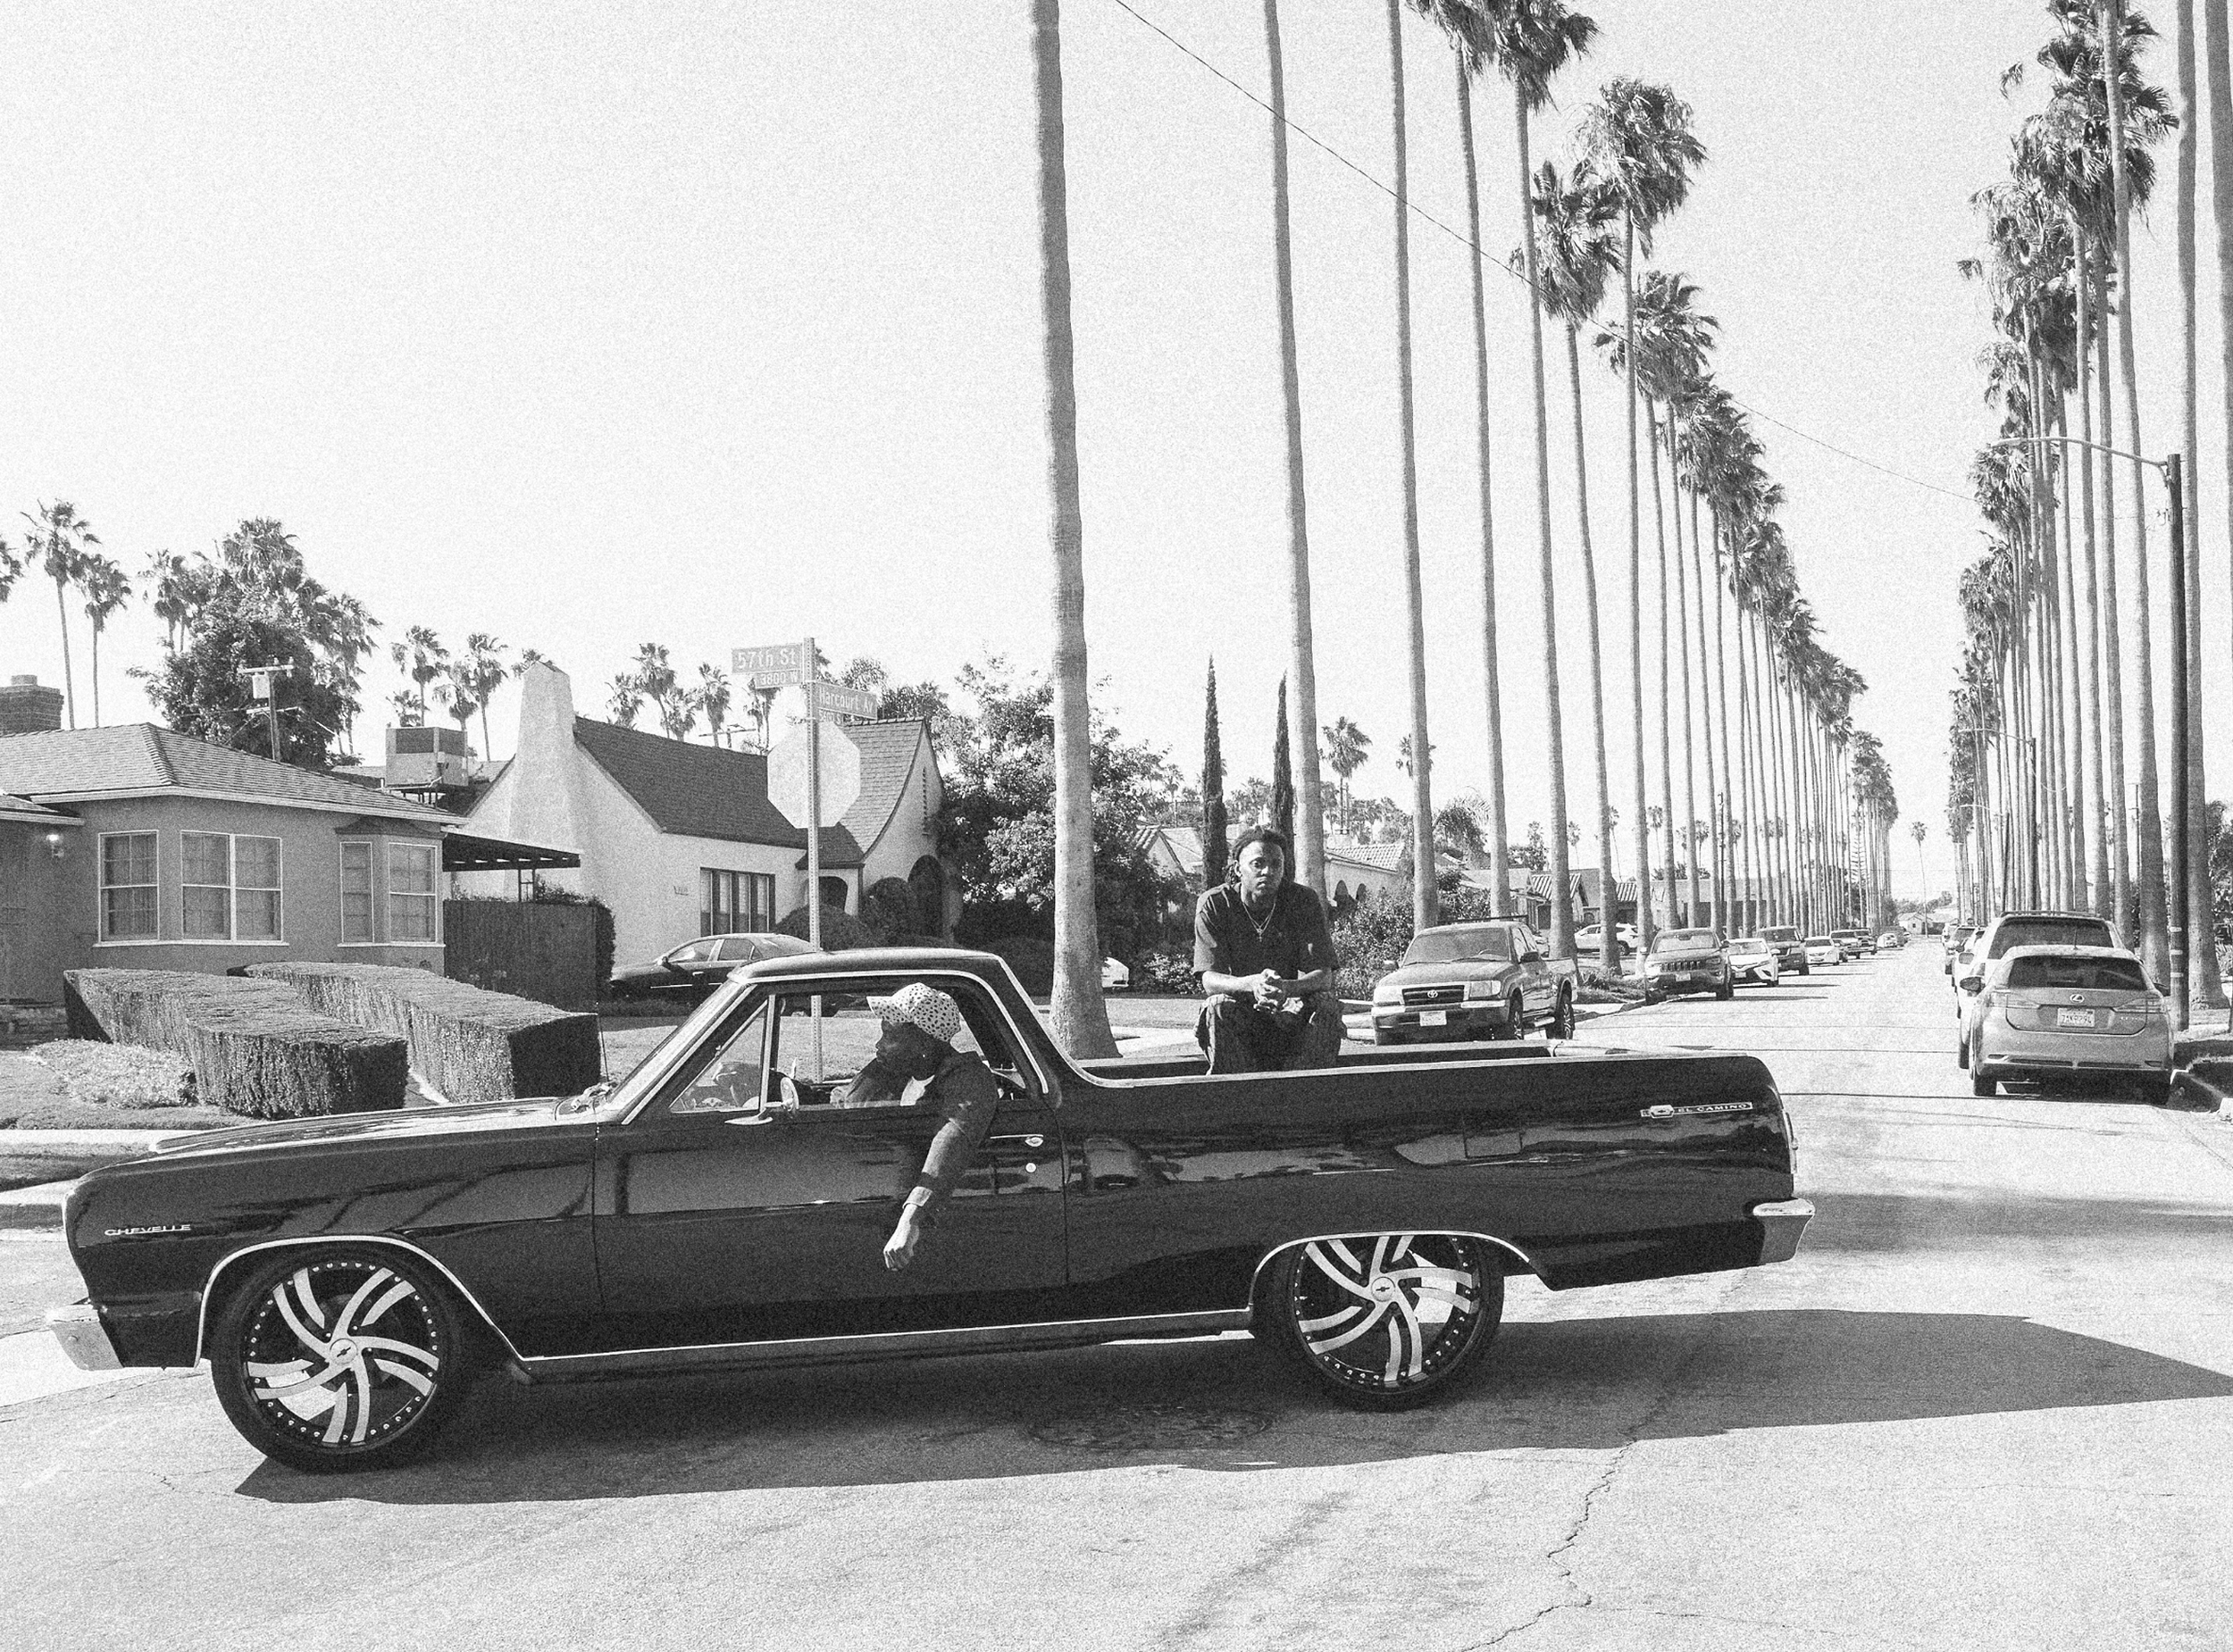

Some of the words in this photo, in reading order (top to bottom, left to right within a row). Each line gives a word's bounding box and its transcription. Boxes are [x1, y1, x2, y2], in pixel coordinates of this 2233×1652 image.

[738, 649, 774, 669] 57th
[780, 647, 796, 665] St
[760, 672, 786, 685] 3800
[790, 671, 799, 683] W
[819, 687, 859, 712] Harcourt
[1696, 1103, 1747, 1113] CAMINO
[104, 1223, 192, 1237] CHEVELLE
